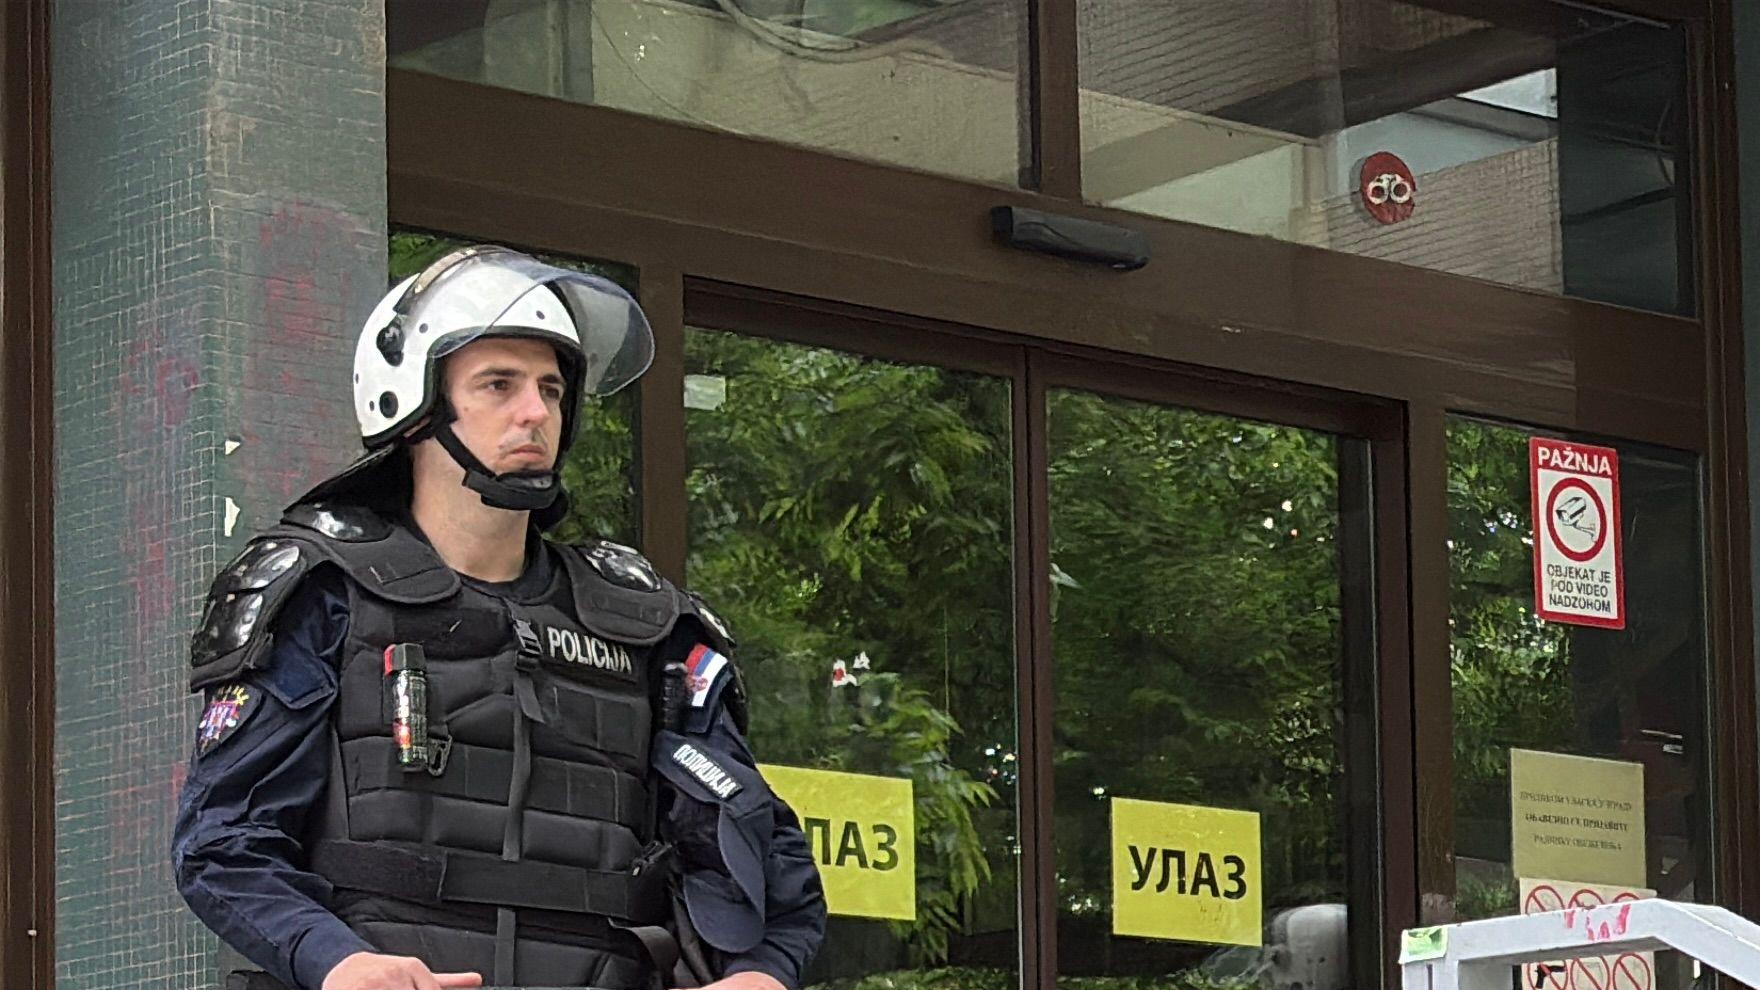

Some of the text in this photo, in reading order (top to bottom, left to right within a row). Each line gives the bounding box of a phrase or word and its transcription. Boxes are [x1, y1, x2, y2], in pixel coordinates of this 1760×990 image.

[1537, 446, 1613, 476] PAŽNJA
[1546, 564, 1612, 584] OBJEKAT JE
[1550, 579, 1609, 598] POD VIDEO
[1548, 594, 1612, 613] NADZOROM
[547, 626, 634, 675] POLICIJA
[804, 816, 900, 872] ЛАЗ
[1128, 844, 1248, 900] УЛАЗ
